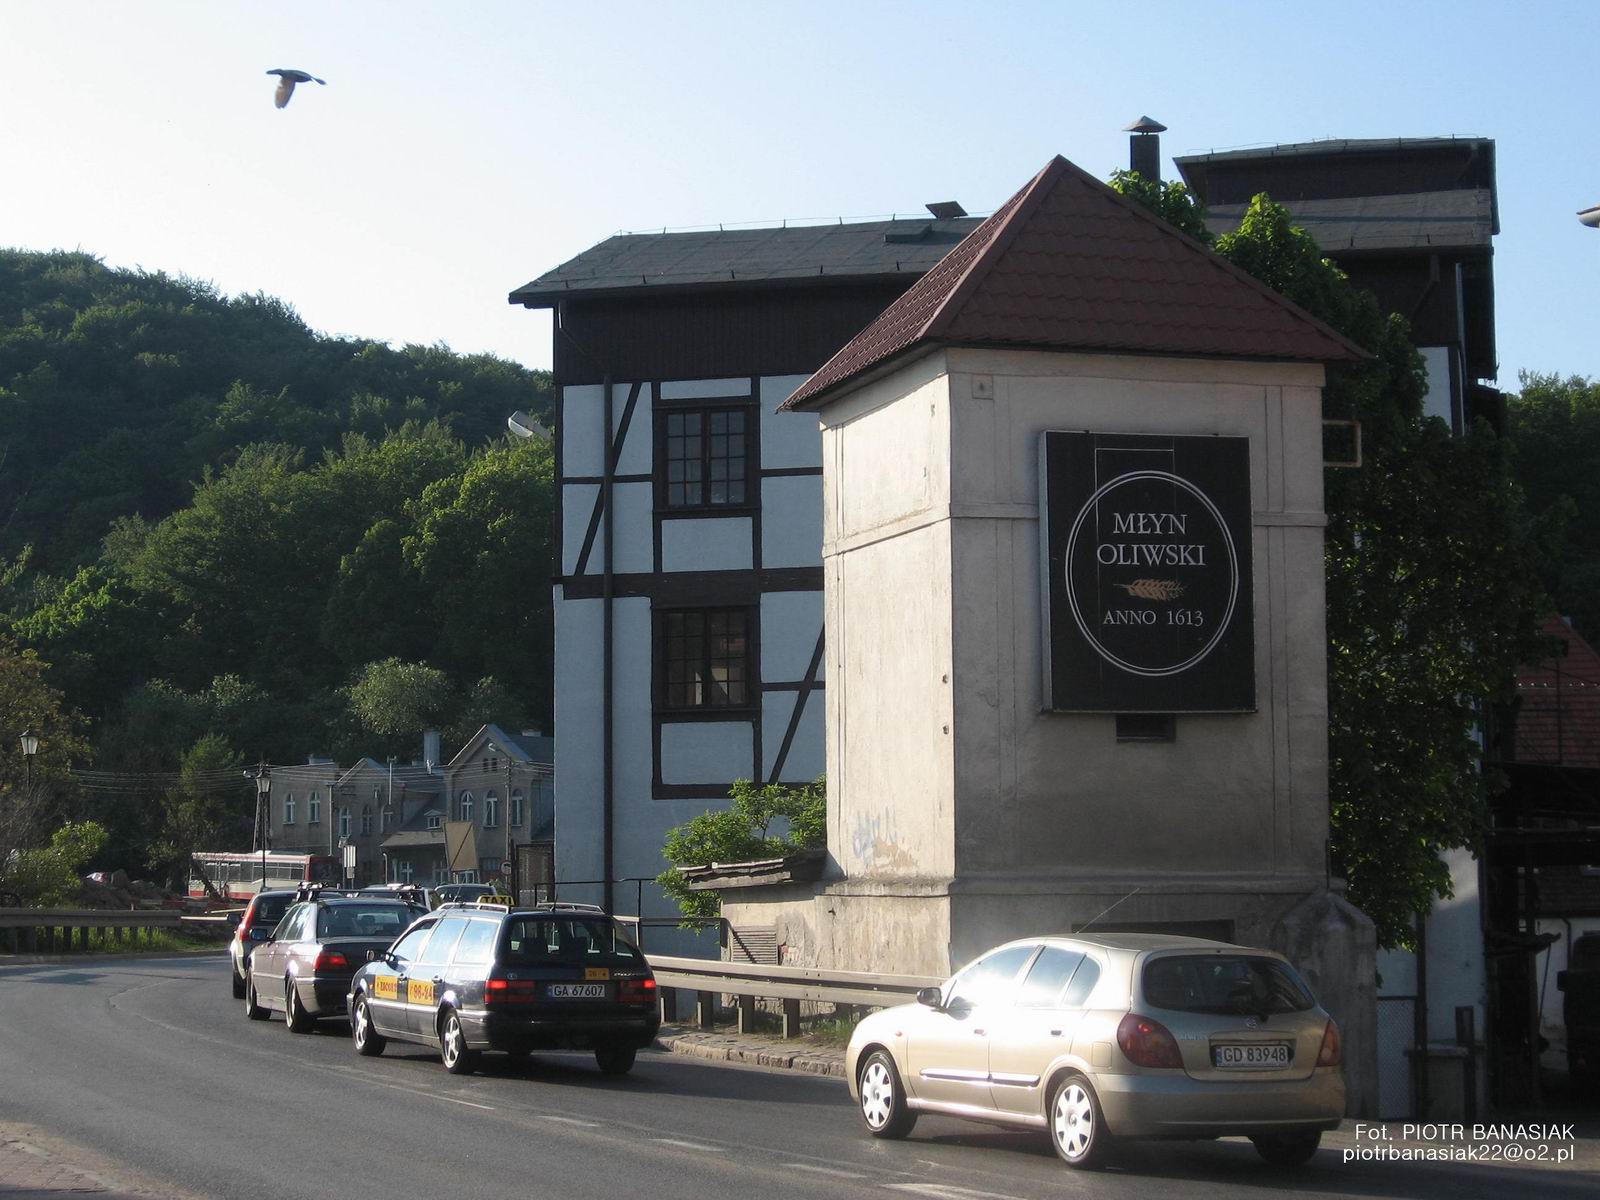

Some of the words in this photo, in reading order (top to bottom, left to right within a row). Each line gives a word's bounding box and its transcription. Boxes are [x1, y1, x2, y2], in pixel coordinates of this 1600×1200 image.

[1112, 513, 1188, 535] MŁYN
[1096, 543, 1207, 567] OLIWSKI
[1103, 610, 1157, 625] ANNO
[1166, 608, 1204, 627] 1613
[481, 895, 512, 905] TAXI
[554, 985, 569, 997] GA
[572, 985, 604, 997] 67607
[1223, 1047, 1243, 1062] GD
[1246, 1047, 1287, 1062] 83948
